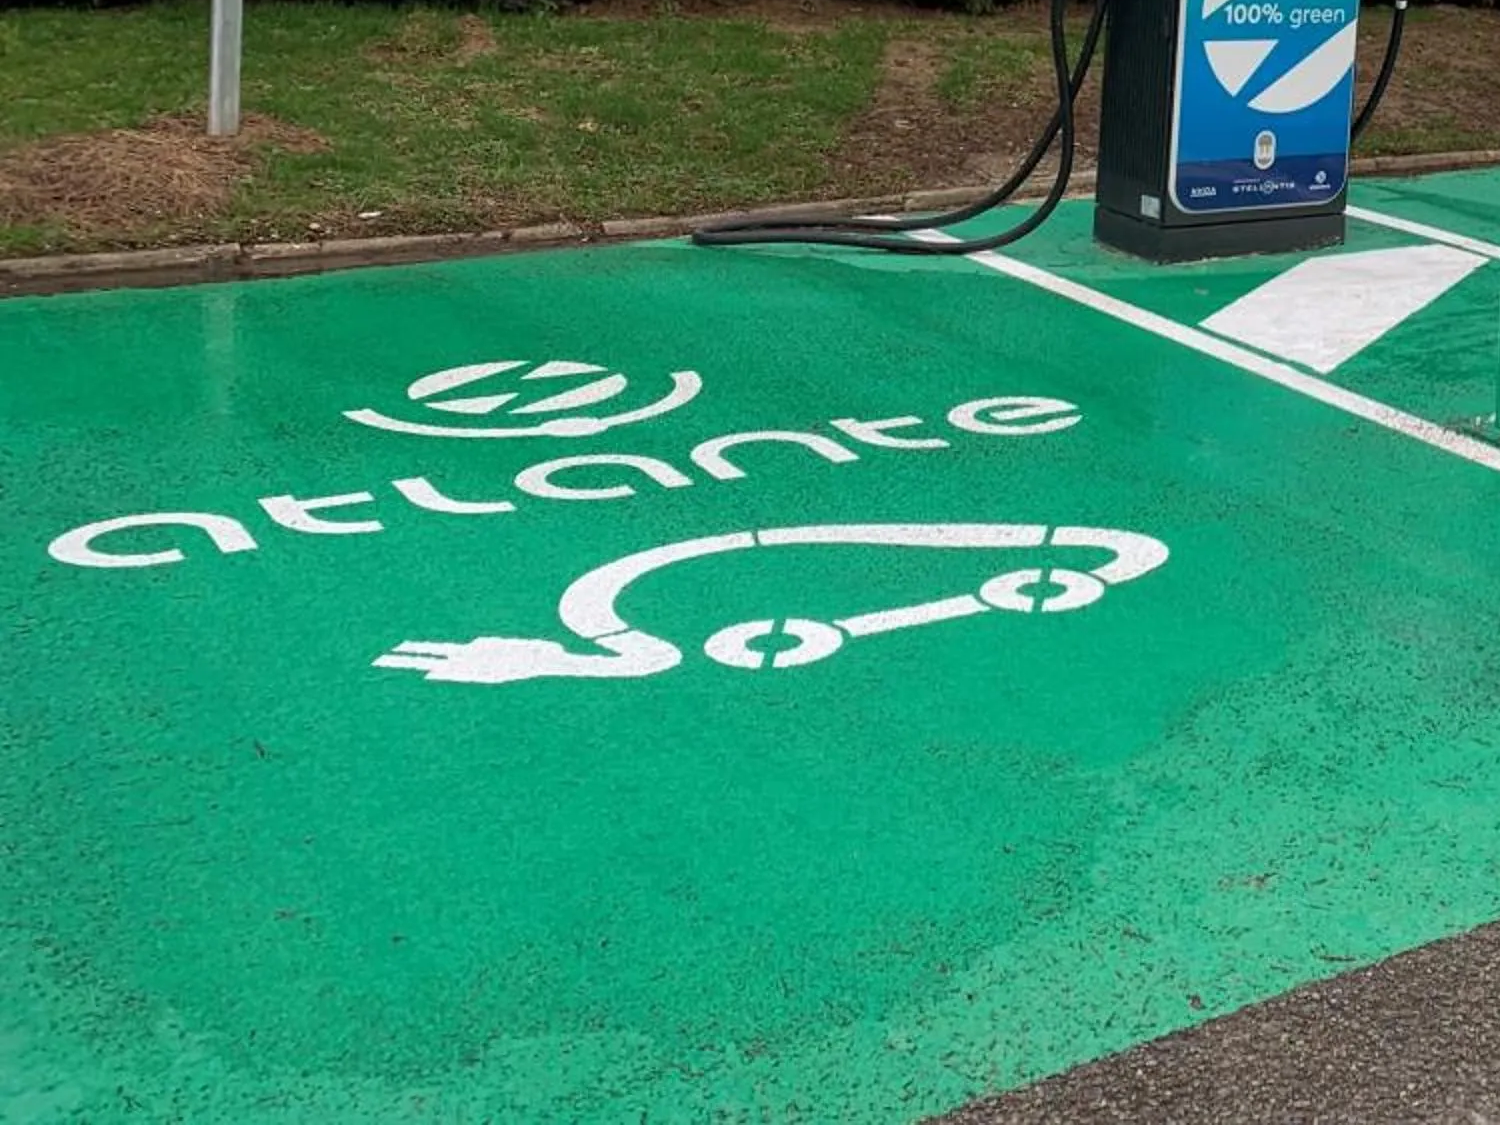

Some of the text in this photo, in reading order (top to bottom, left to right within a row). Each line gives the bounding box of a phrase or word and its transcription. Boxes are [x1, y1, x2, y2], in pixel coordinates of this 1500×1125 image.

[1222, 2, 1346, 29] 100% green
[47, 395, 1083, 569] atlante
